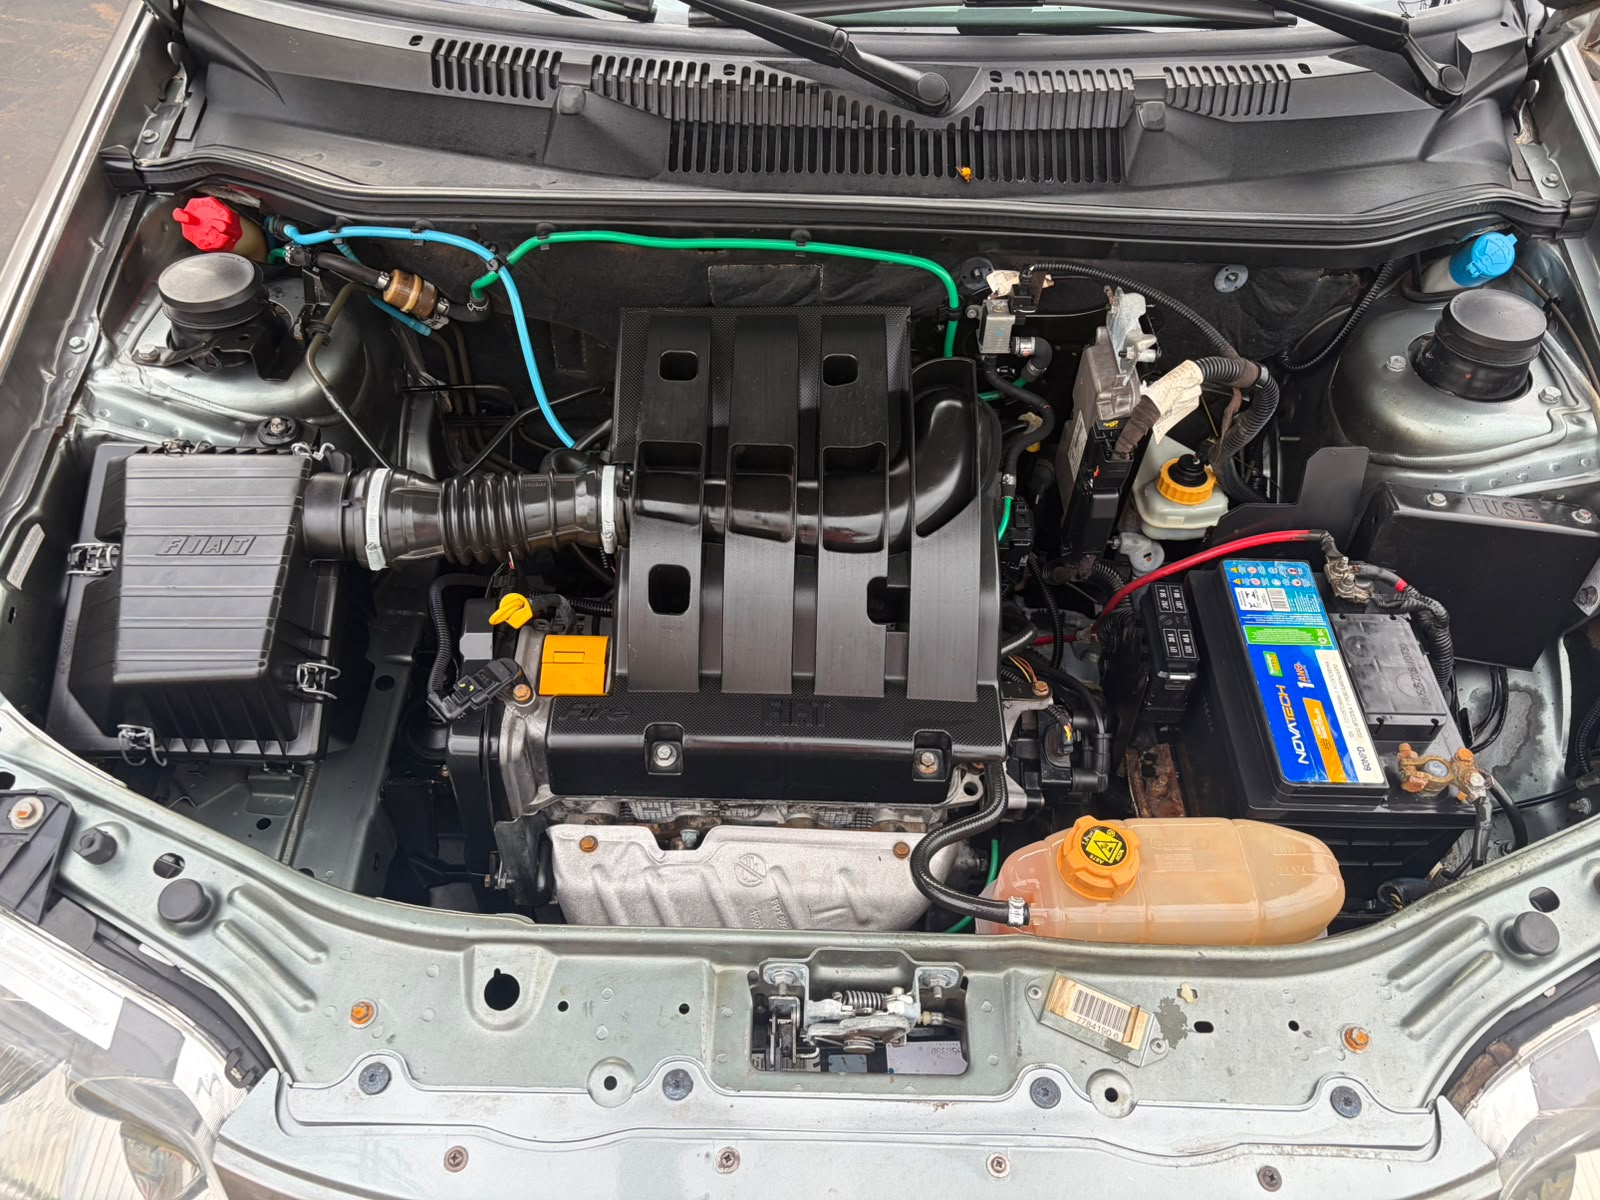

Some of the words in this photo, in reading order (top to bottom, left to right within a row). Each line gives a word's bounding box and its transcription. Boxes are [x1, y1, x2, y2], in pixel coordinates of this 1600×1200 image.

[1467, 497, 1538, 520] FUSE
[162, 536, 252, 555] FIAT
[1275, 684, 1310, 765] NOVATECH
[1076, 1015, 1112, 1037] 7784190
[1113, 1032, 1120, 1041] 6
